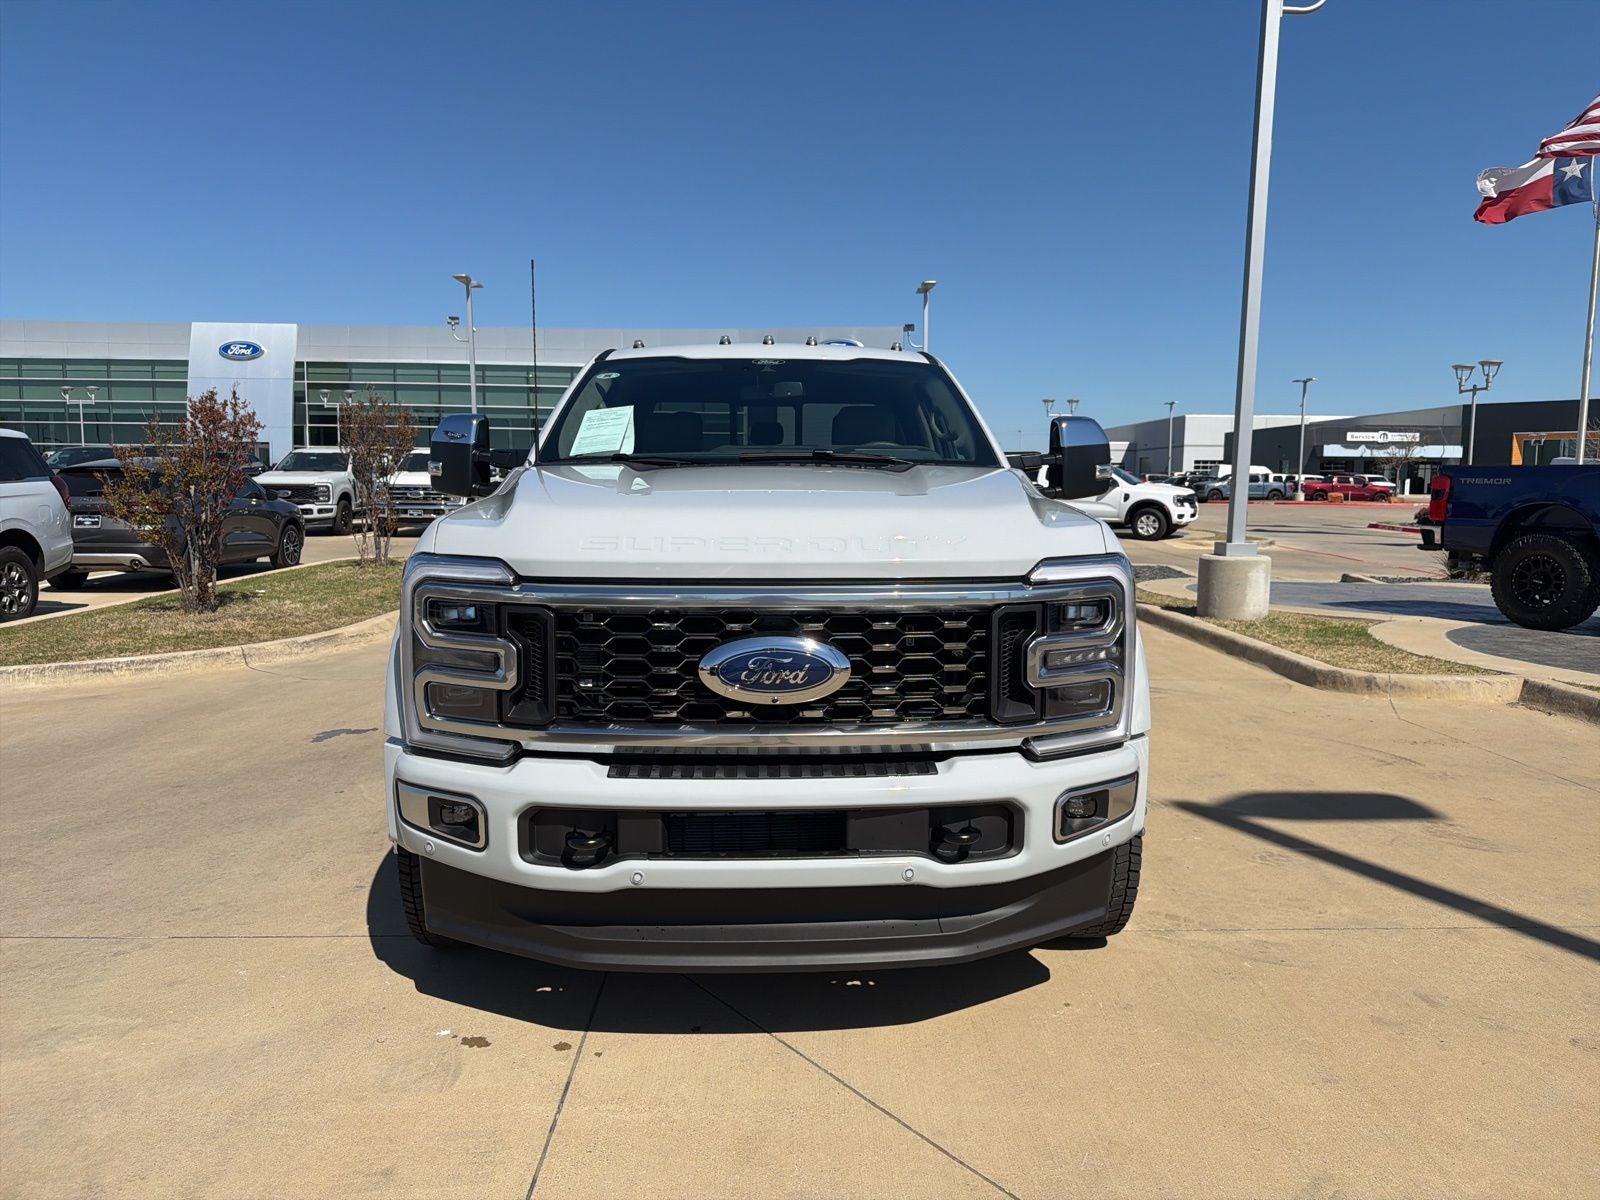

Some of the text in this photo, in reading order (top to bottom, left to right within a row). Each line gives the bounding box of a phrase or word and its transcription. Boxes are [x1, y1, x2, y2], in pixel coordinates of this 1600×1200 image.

[227, 344, 253, 355] Ford
[1460, 477, 1512, 485] TREMOR
[578, 534, 969, 553] SUPER DUTY
[740, 656, 811, 685] Ford
